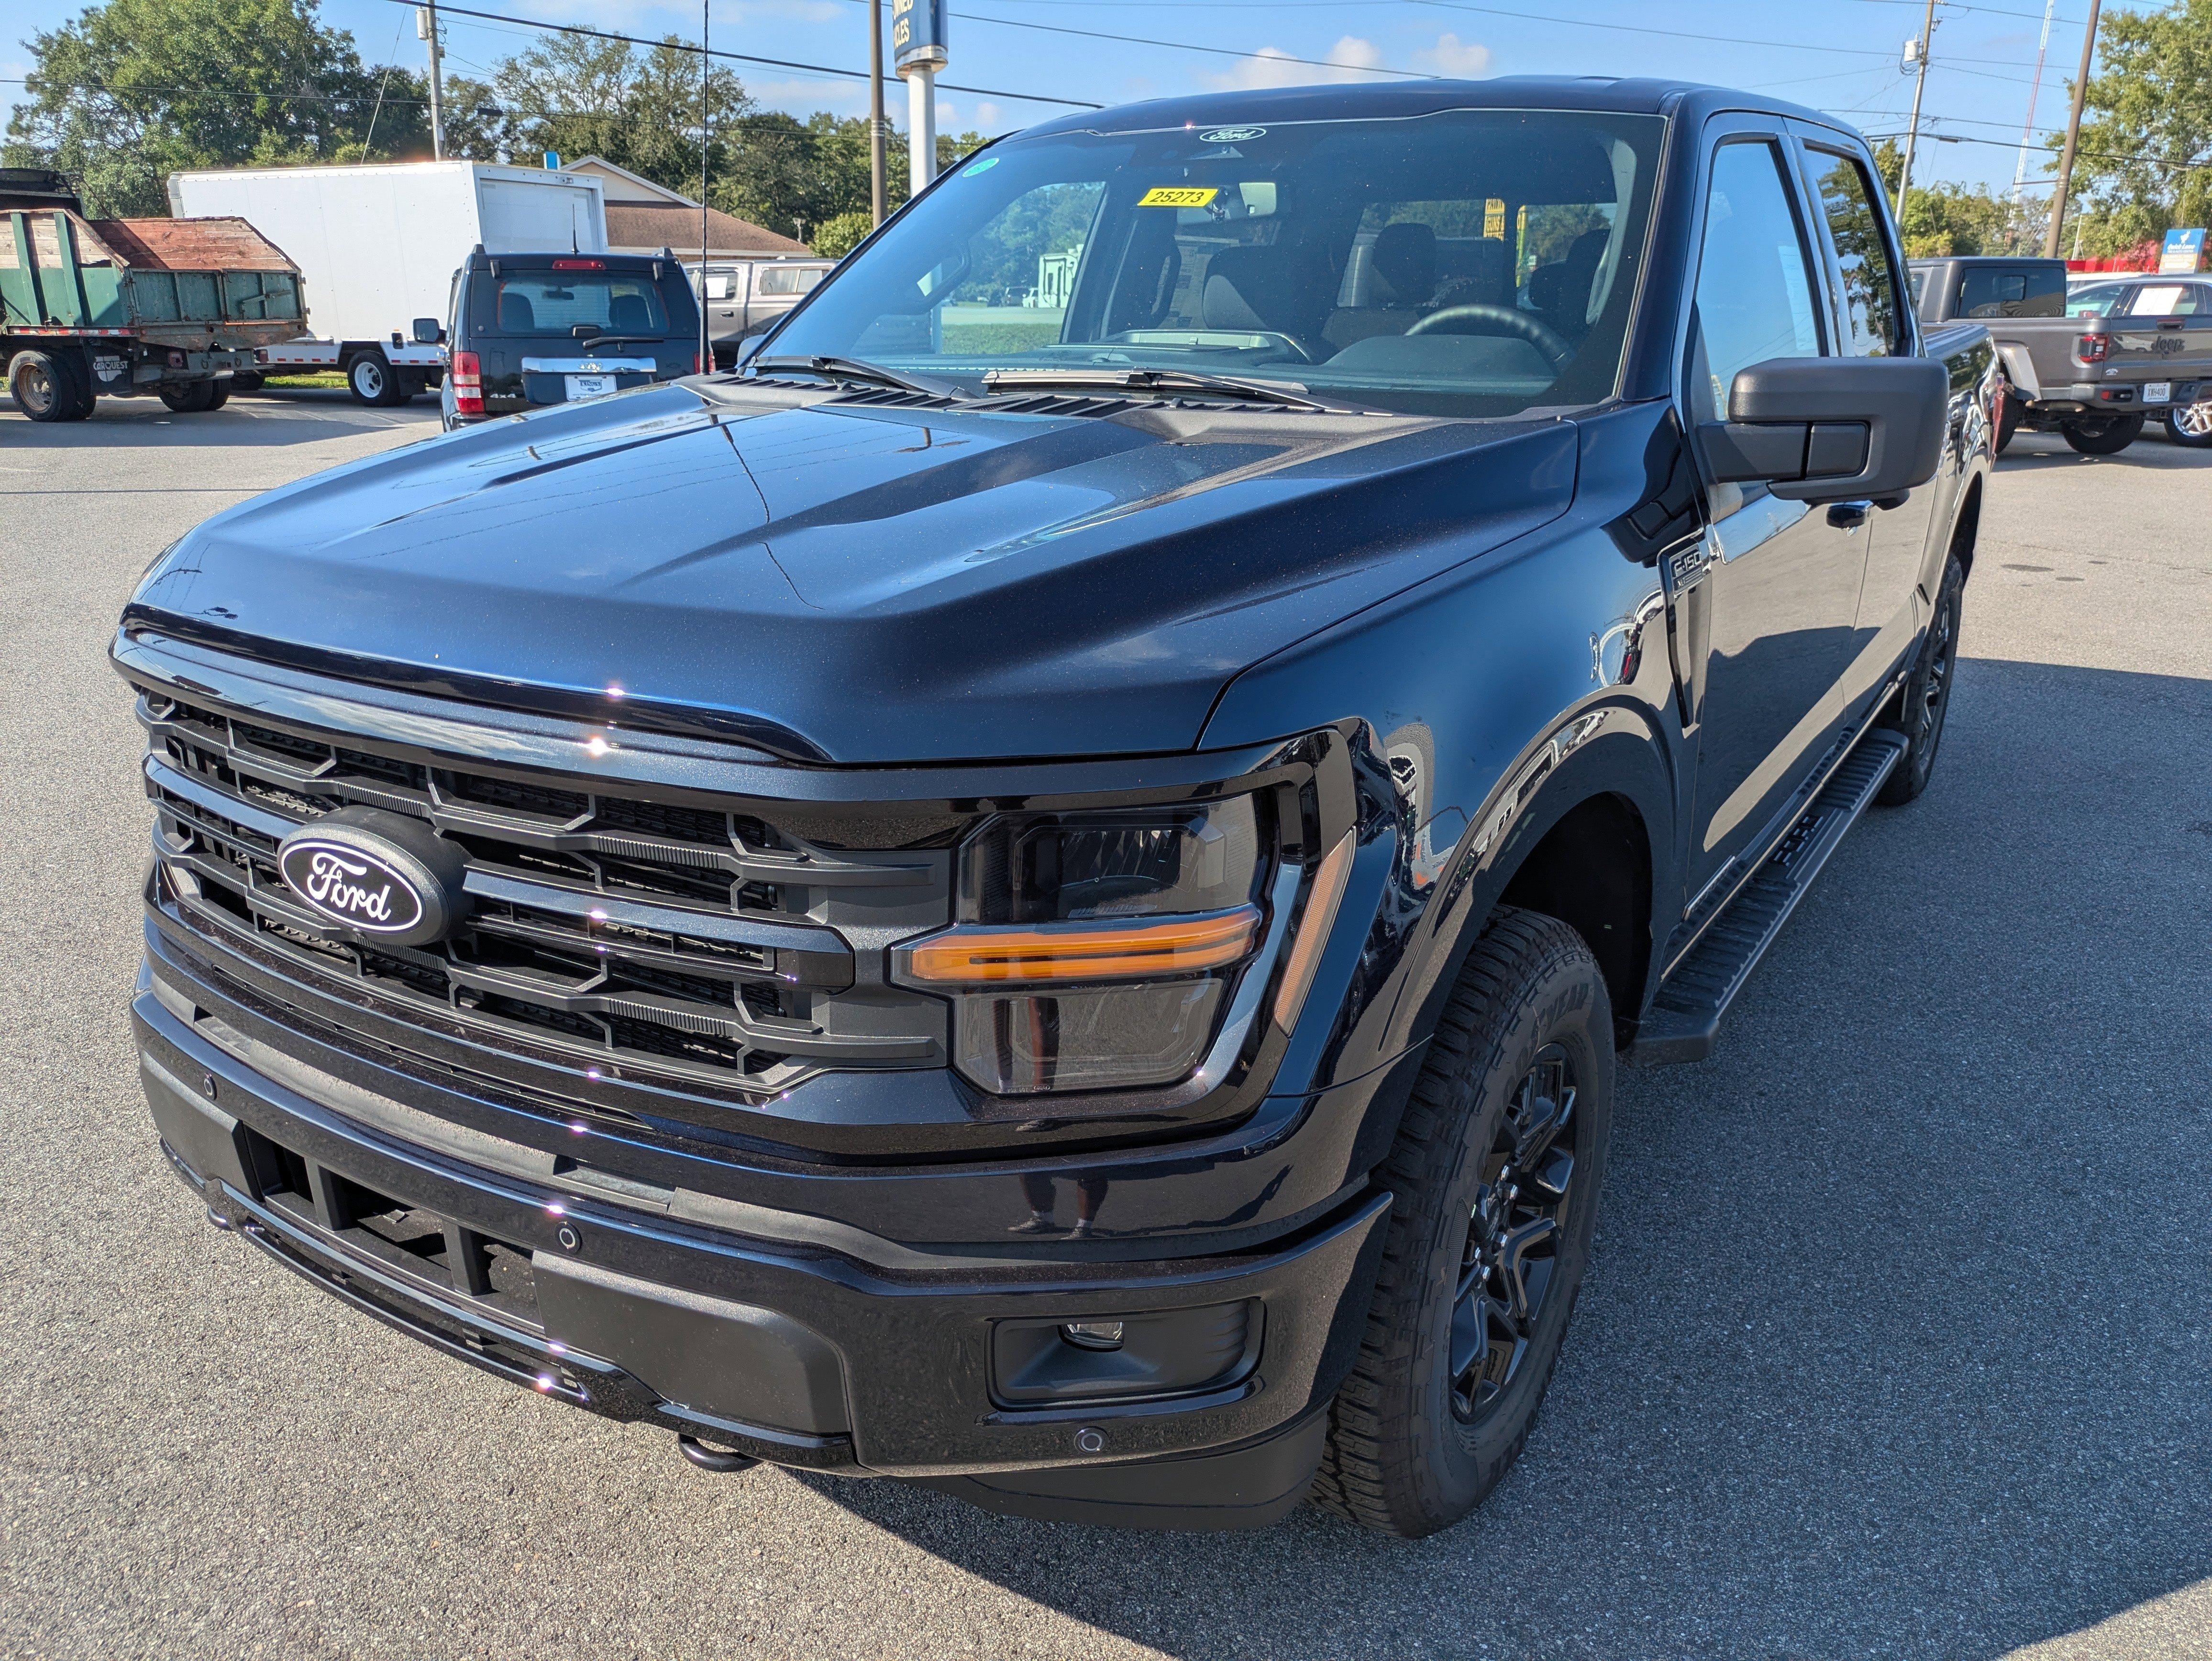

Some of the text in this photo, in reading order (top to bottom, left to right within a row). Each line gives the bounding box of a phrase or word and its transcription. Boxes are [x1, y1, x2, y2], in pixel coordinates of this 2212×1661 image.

[1209, 129, 1256, 140] Ford
[1149, 191, 1205, 203] 25273
[1487, 215, 1500, 231] GUNS
[2151, 336, 2185, 352] Jeep
[93, 361, 128, 371] CARQUEST
[1674, 551, 1702, 577] F-150
[307, 853, 391, 921] Ford
